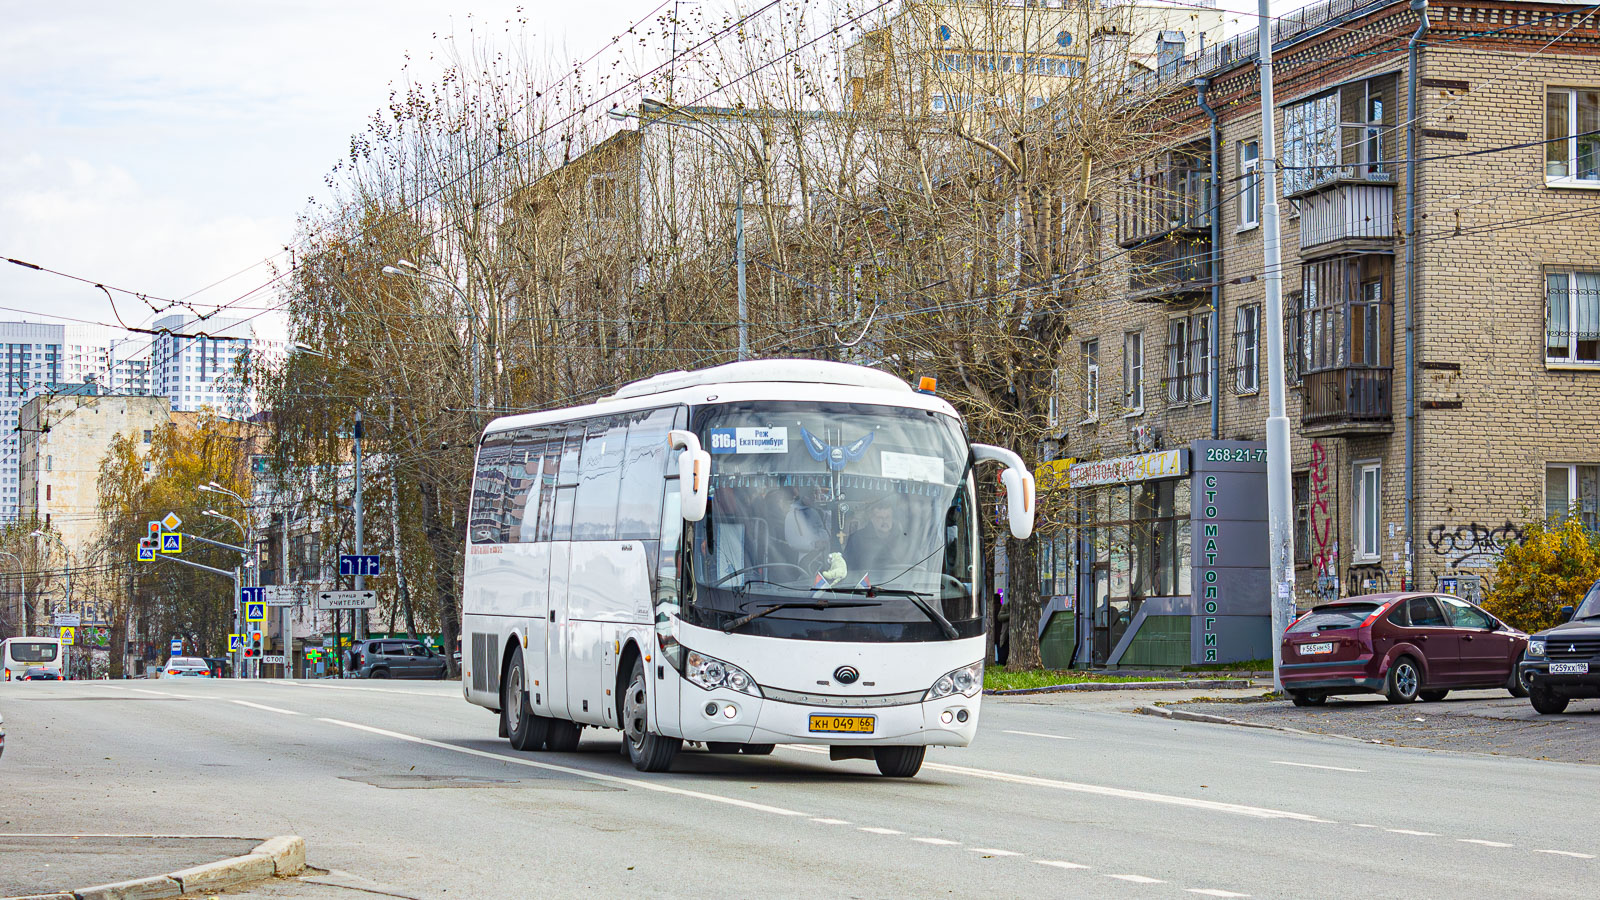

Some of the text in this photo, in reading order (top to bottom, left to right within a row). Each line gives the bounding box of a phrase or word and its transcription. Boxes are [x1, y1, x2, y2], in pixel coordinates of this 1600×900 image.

[740, 438, 784, 446] Екатеринбург
[1135, 450, 1180, 479] ЭСТА
[1204, 475, 1219, 662] СТОМАТОЛОГИЯ
[329, 598, 366, 607] УЧИТЕЛЕЙ
[815, 718, 870, 730] КН 049 66
